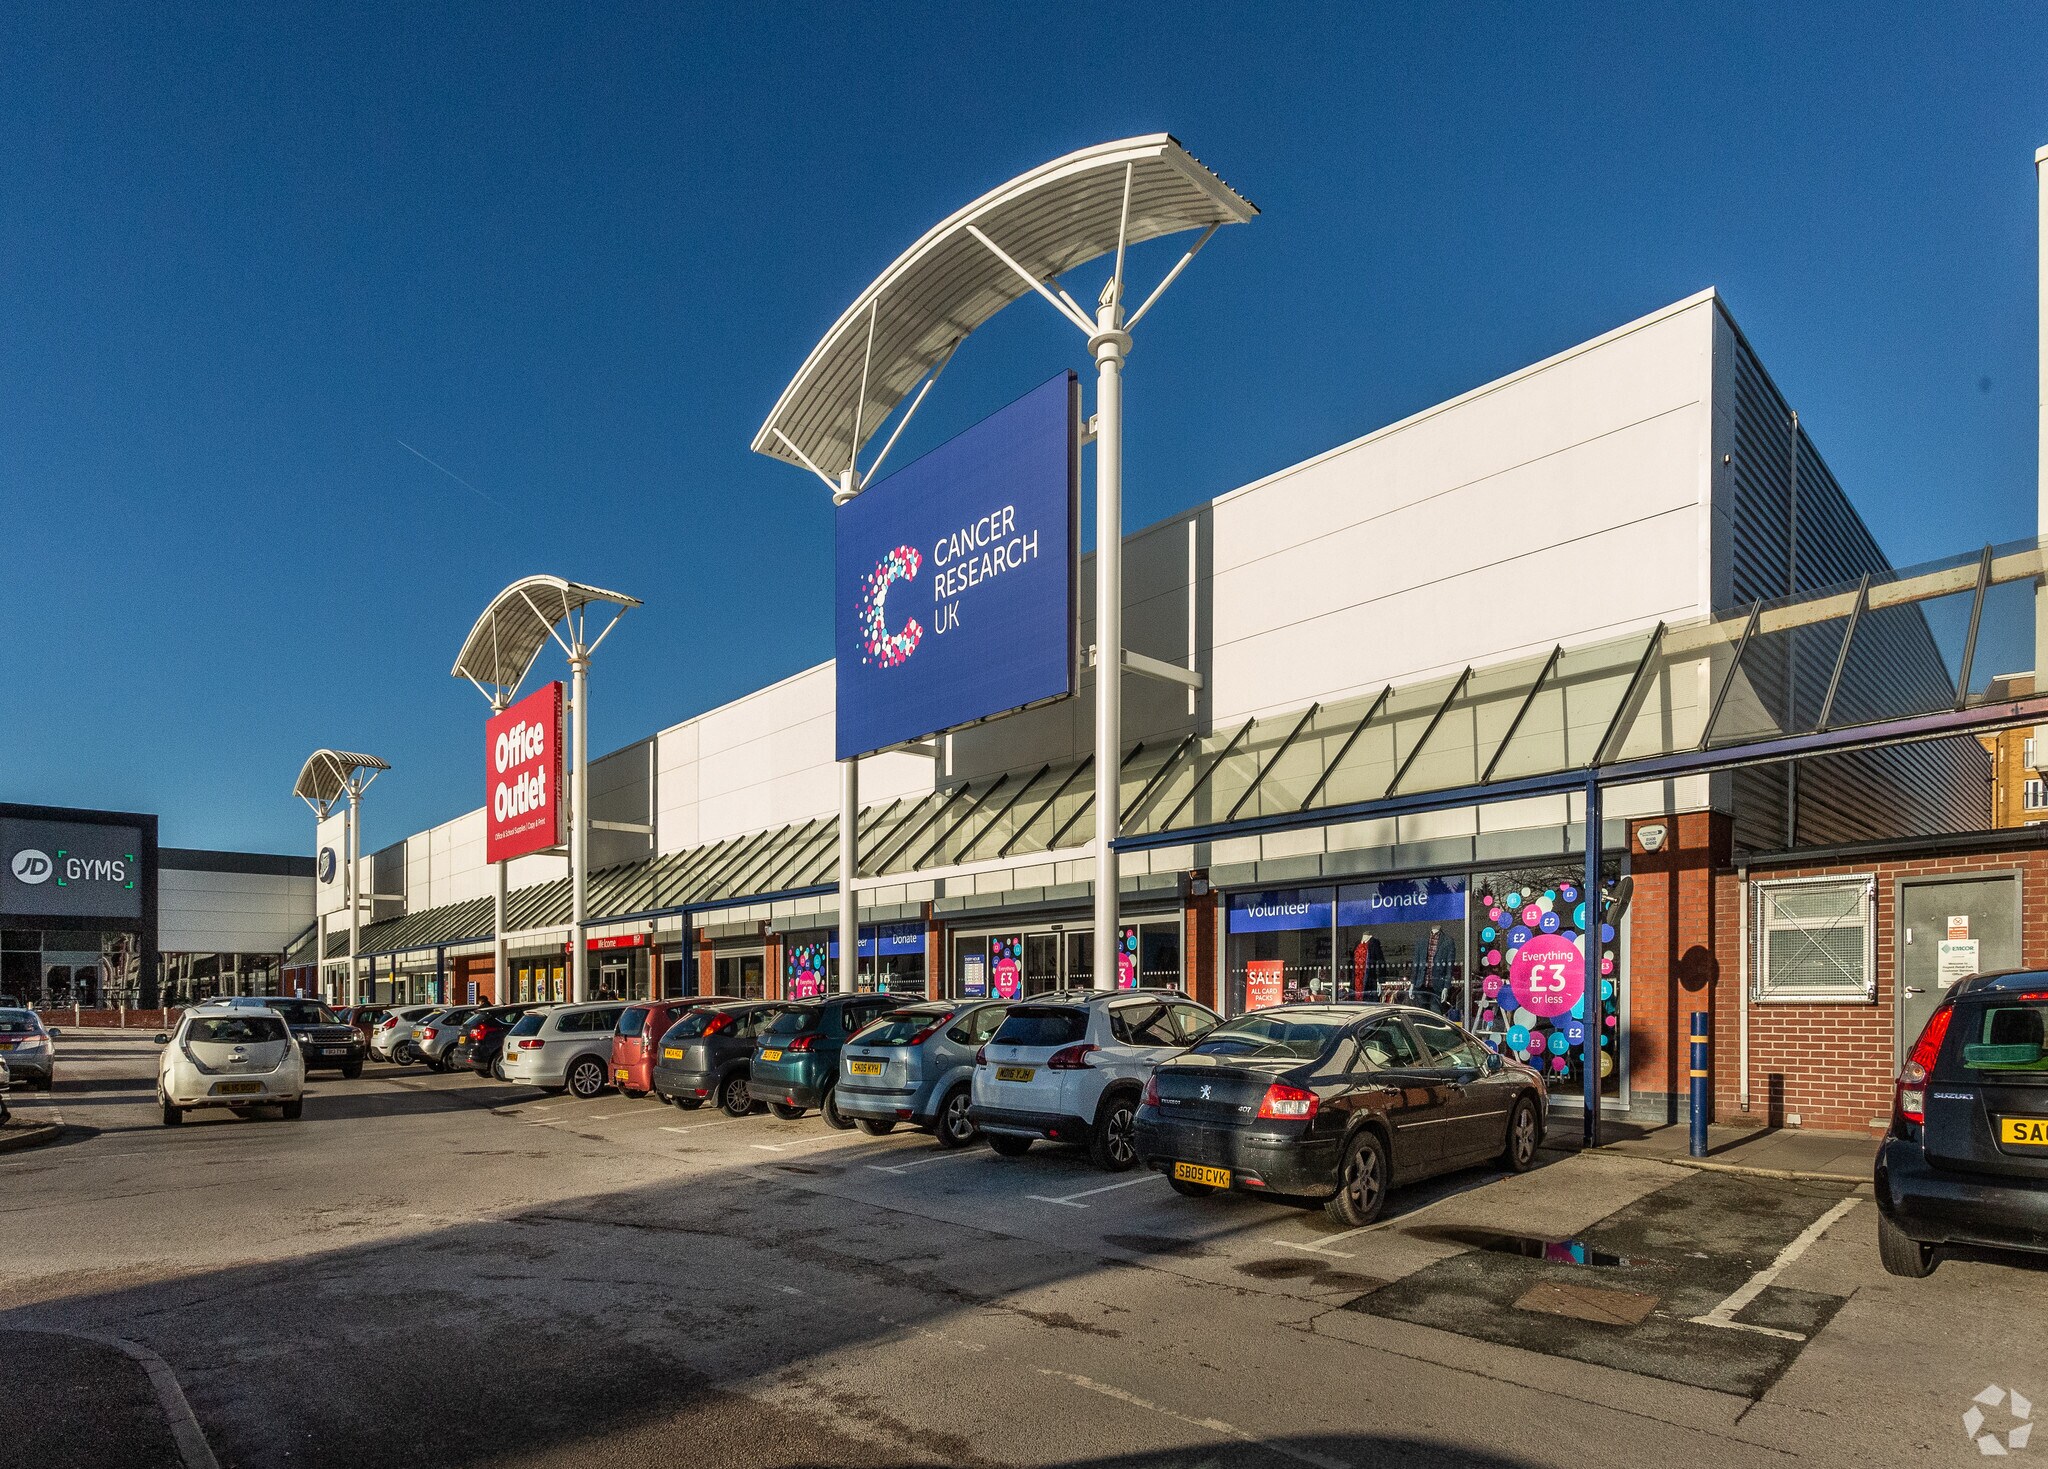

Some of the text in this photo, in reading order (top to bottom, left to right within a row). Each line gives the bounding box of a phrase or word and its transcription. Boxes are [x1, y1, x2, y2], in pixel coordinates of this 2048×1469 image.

[934, 505, 1015, 567] CANCER
[934, 530, 1038, 602] RESEARCH
[934, 601, 960, 635] UK
[495, 721, 544, 774] Office
[494, 764, 546, 823] Outlet
[17, 857, 48, 876] JD
[66, 858, 125, 882] GYMS
[1371, 892, 1428, 909] Donate
[1247, 901, 1310, 918] Volunteer
[1526, 911, 1538, 920] £3
[1544, 918, 1556, 927] £2
[598, 938, 616, 949] Welcome
[892, 934, 917, 945] Donate
[1513, 934, 1526, 943] £2
[1522, 950, 1574, 963] Everything
[1000, 972, 1012, 986] £3
[1118, 968, 1126, 983] 3
[1248, 971, 1280, 985] SALE
[1529, 964, 1566, 992] £3
[1487, 982, 1498, 990] £3
[1544, 995, 1563, 1004] less
[1512, 1034, 1524, 1042] £1
[1568, 1028, 1582, 1038] £2
[1530, 1040, 1540, 1048] £3
[1552, 1040, 1564, 1048] £1
[1934, 1092, 1974, 1100] SUZUKI
[1238, 1106, 1252, 1114] 407
[2013, 1122, 2048, 1142] SA
[1179, 1164, 1226, 1186] SB09 CVK
